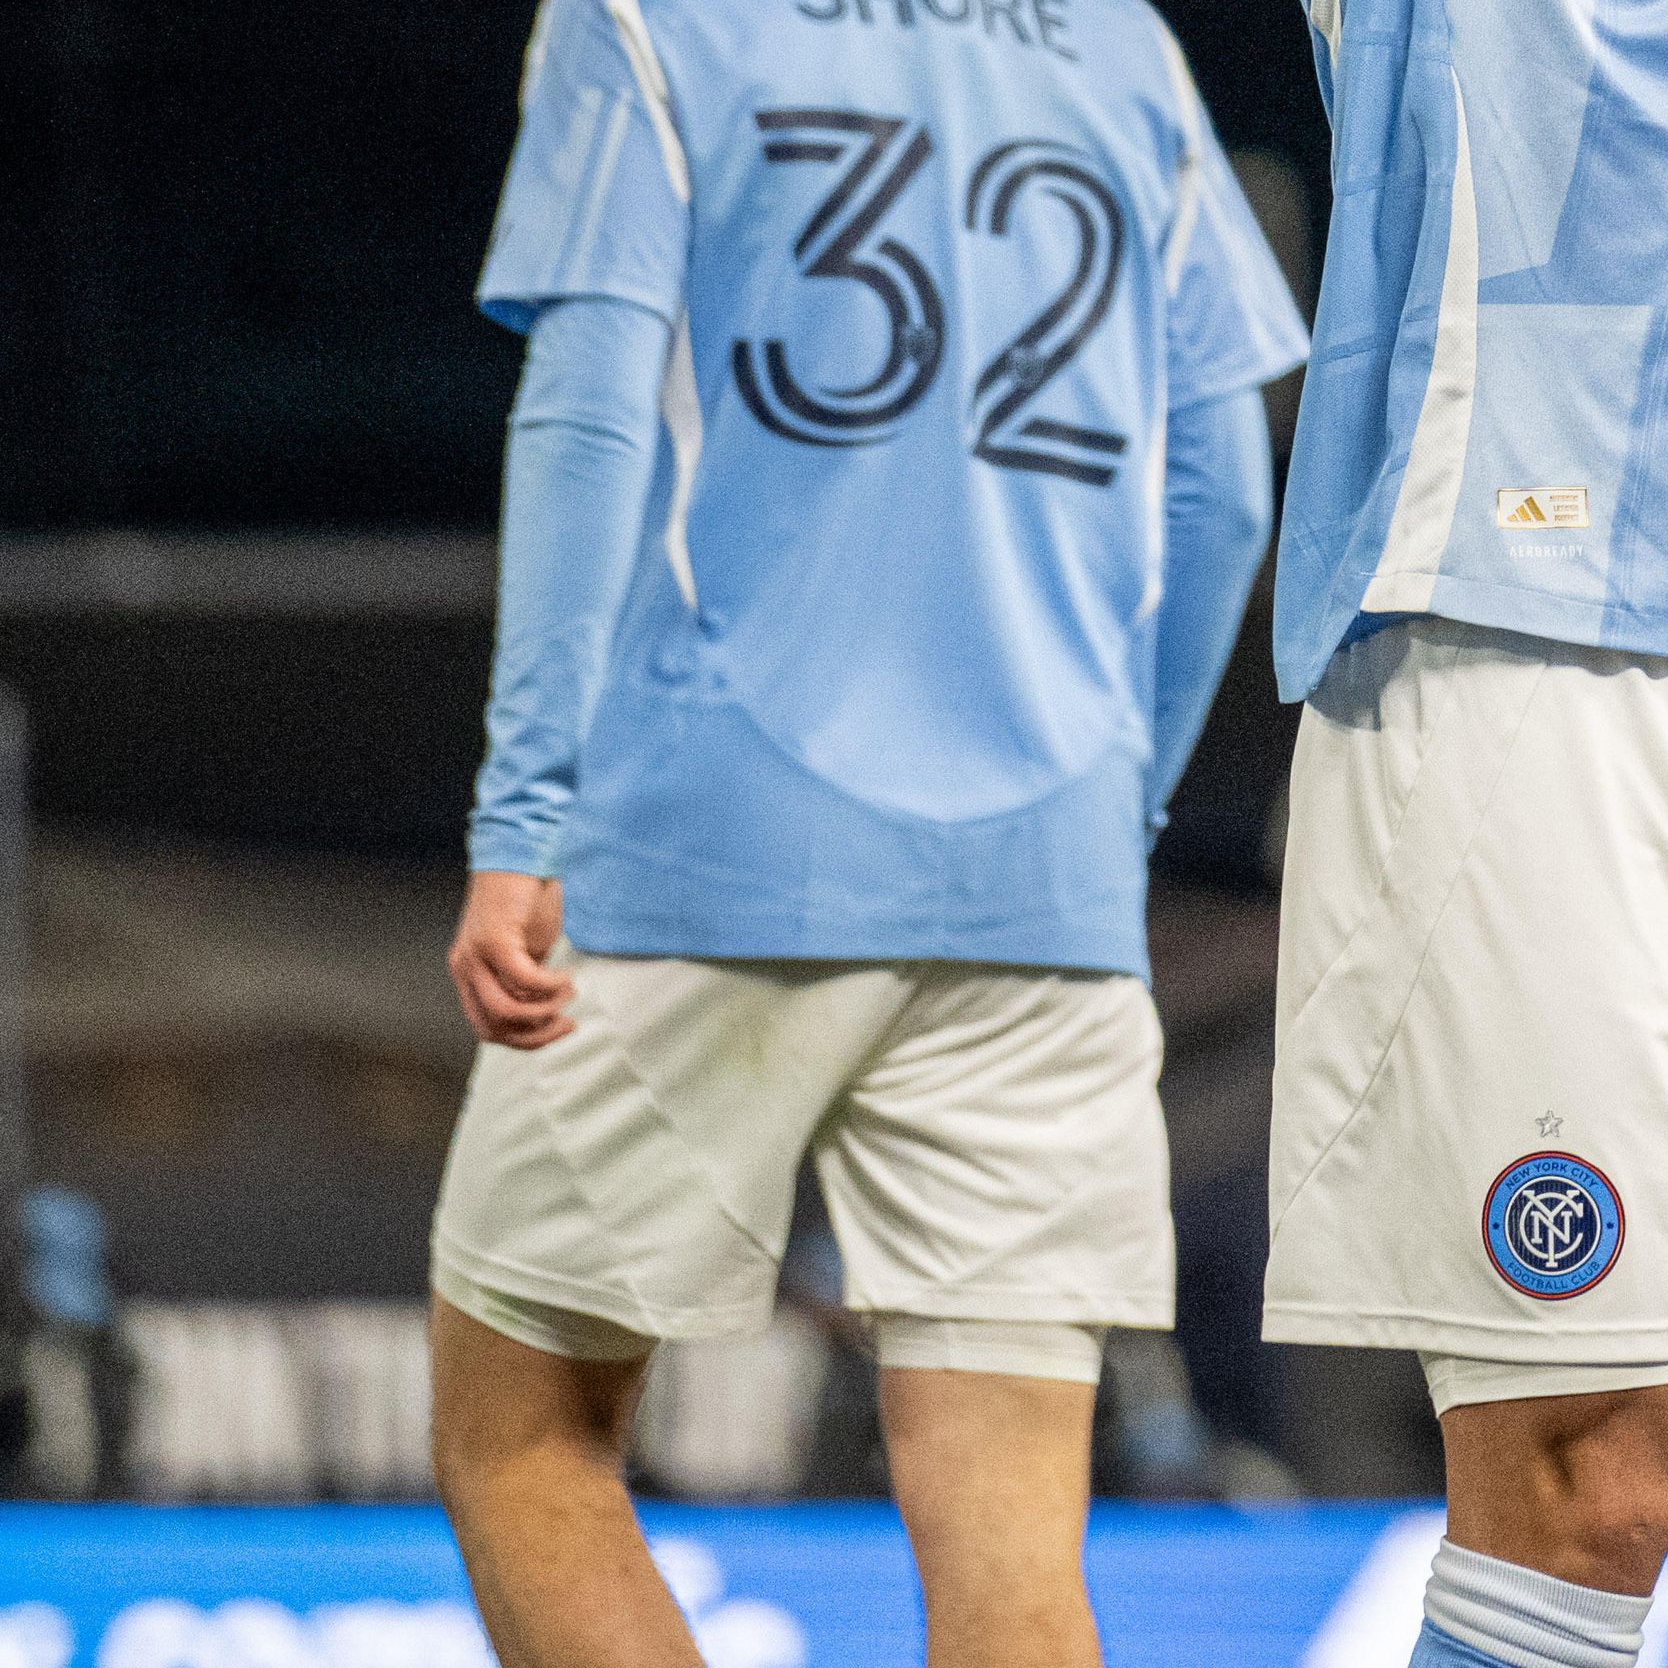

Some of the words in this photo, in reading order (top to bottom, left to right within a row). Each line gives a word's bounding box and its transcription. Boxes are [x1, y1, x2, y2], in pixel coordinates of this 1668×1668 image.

[731, 108, 1129, 488] 32
[1509, 544, 1584, 558] AEROREADY
[1505, 1166, 1531, 1190] NEW
[1535, 1161, 1568, 1173] YORK
[1571, 1167, 1599, 1188] CITY
[1507, 1261, 1568, 1291] FOOTBALL
[1571, 1260, 1601, 1283] CLUB
